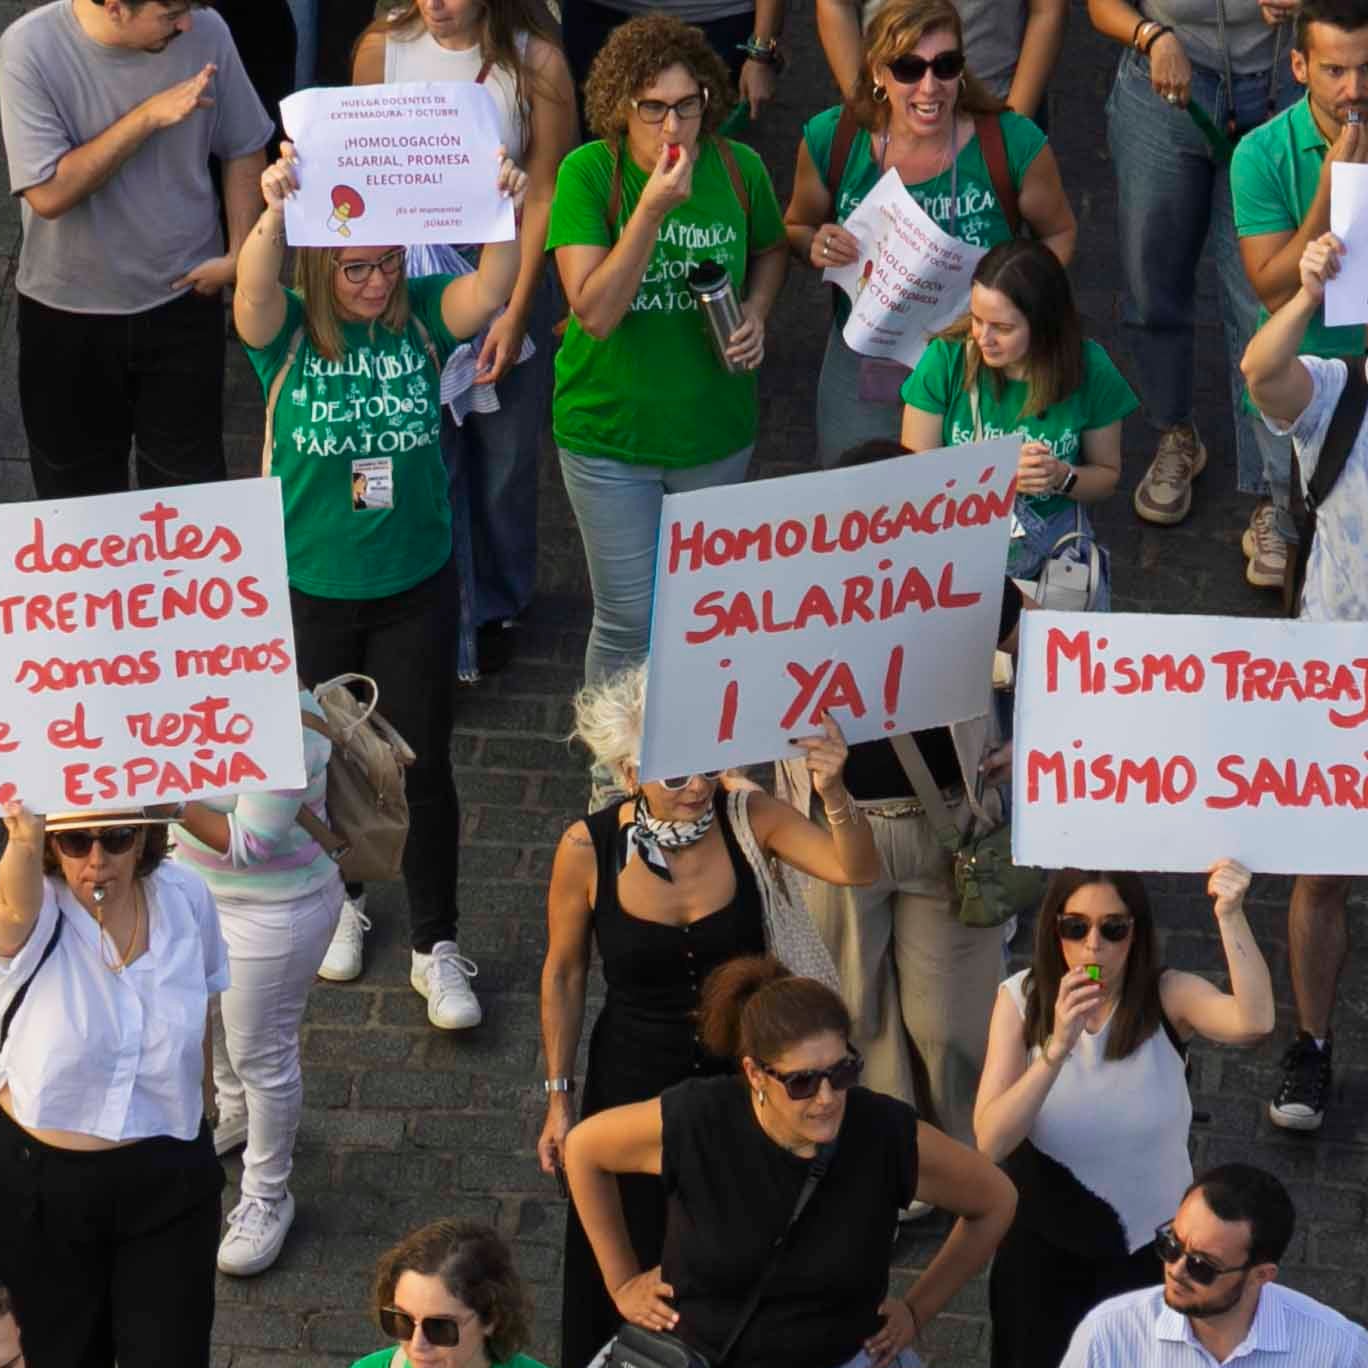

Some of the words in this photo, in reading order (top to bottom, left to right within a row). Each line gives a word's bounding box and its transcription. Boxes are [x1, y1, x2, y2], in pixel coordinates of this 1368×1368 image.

[341, 97, 380, 108] HUELGA
[381, 96, 434, 106] DOCENTES
[435, 96, 447, 105] DE
[416, 107, 459, 118] OCTUBRE
[344, 132, 462, 150] ¡HOMOLOGACIÓN
[337, 155, 403, 168] SALARIAL,
[407, 152, 470, 166] PROMESA
[366, 173, 443, 186] ELECTORAL!
[678, 222, 737, 248] PÚBLICA
[15, 502, 243, 574] docentes
[15, 649, 161, 693] somos
[175, 637, 291, 678] menos
[47, 702, 104, 749] el
[126, 695, 254, 748] resto
[62, 748, 268, 805] ESPAÑA
